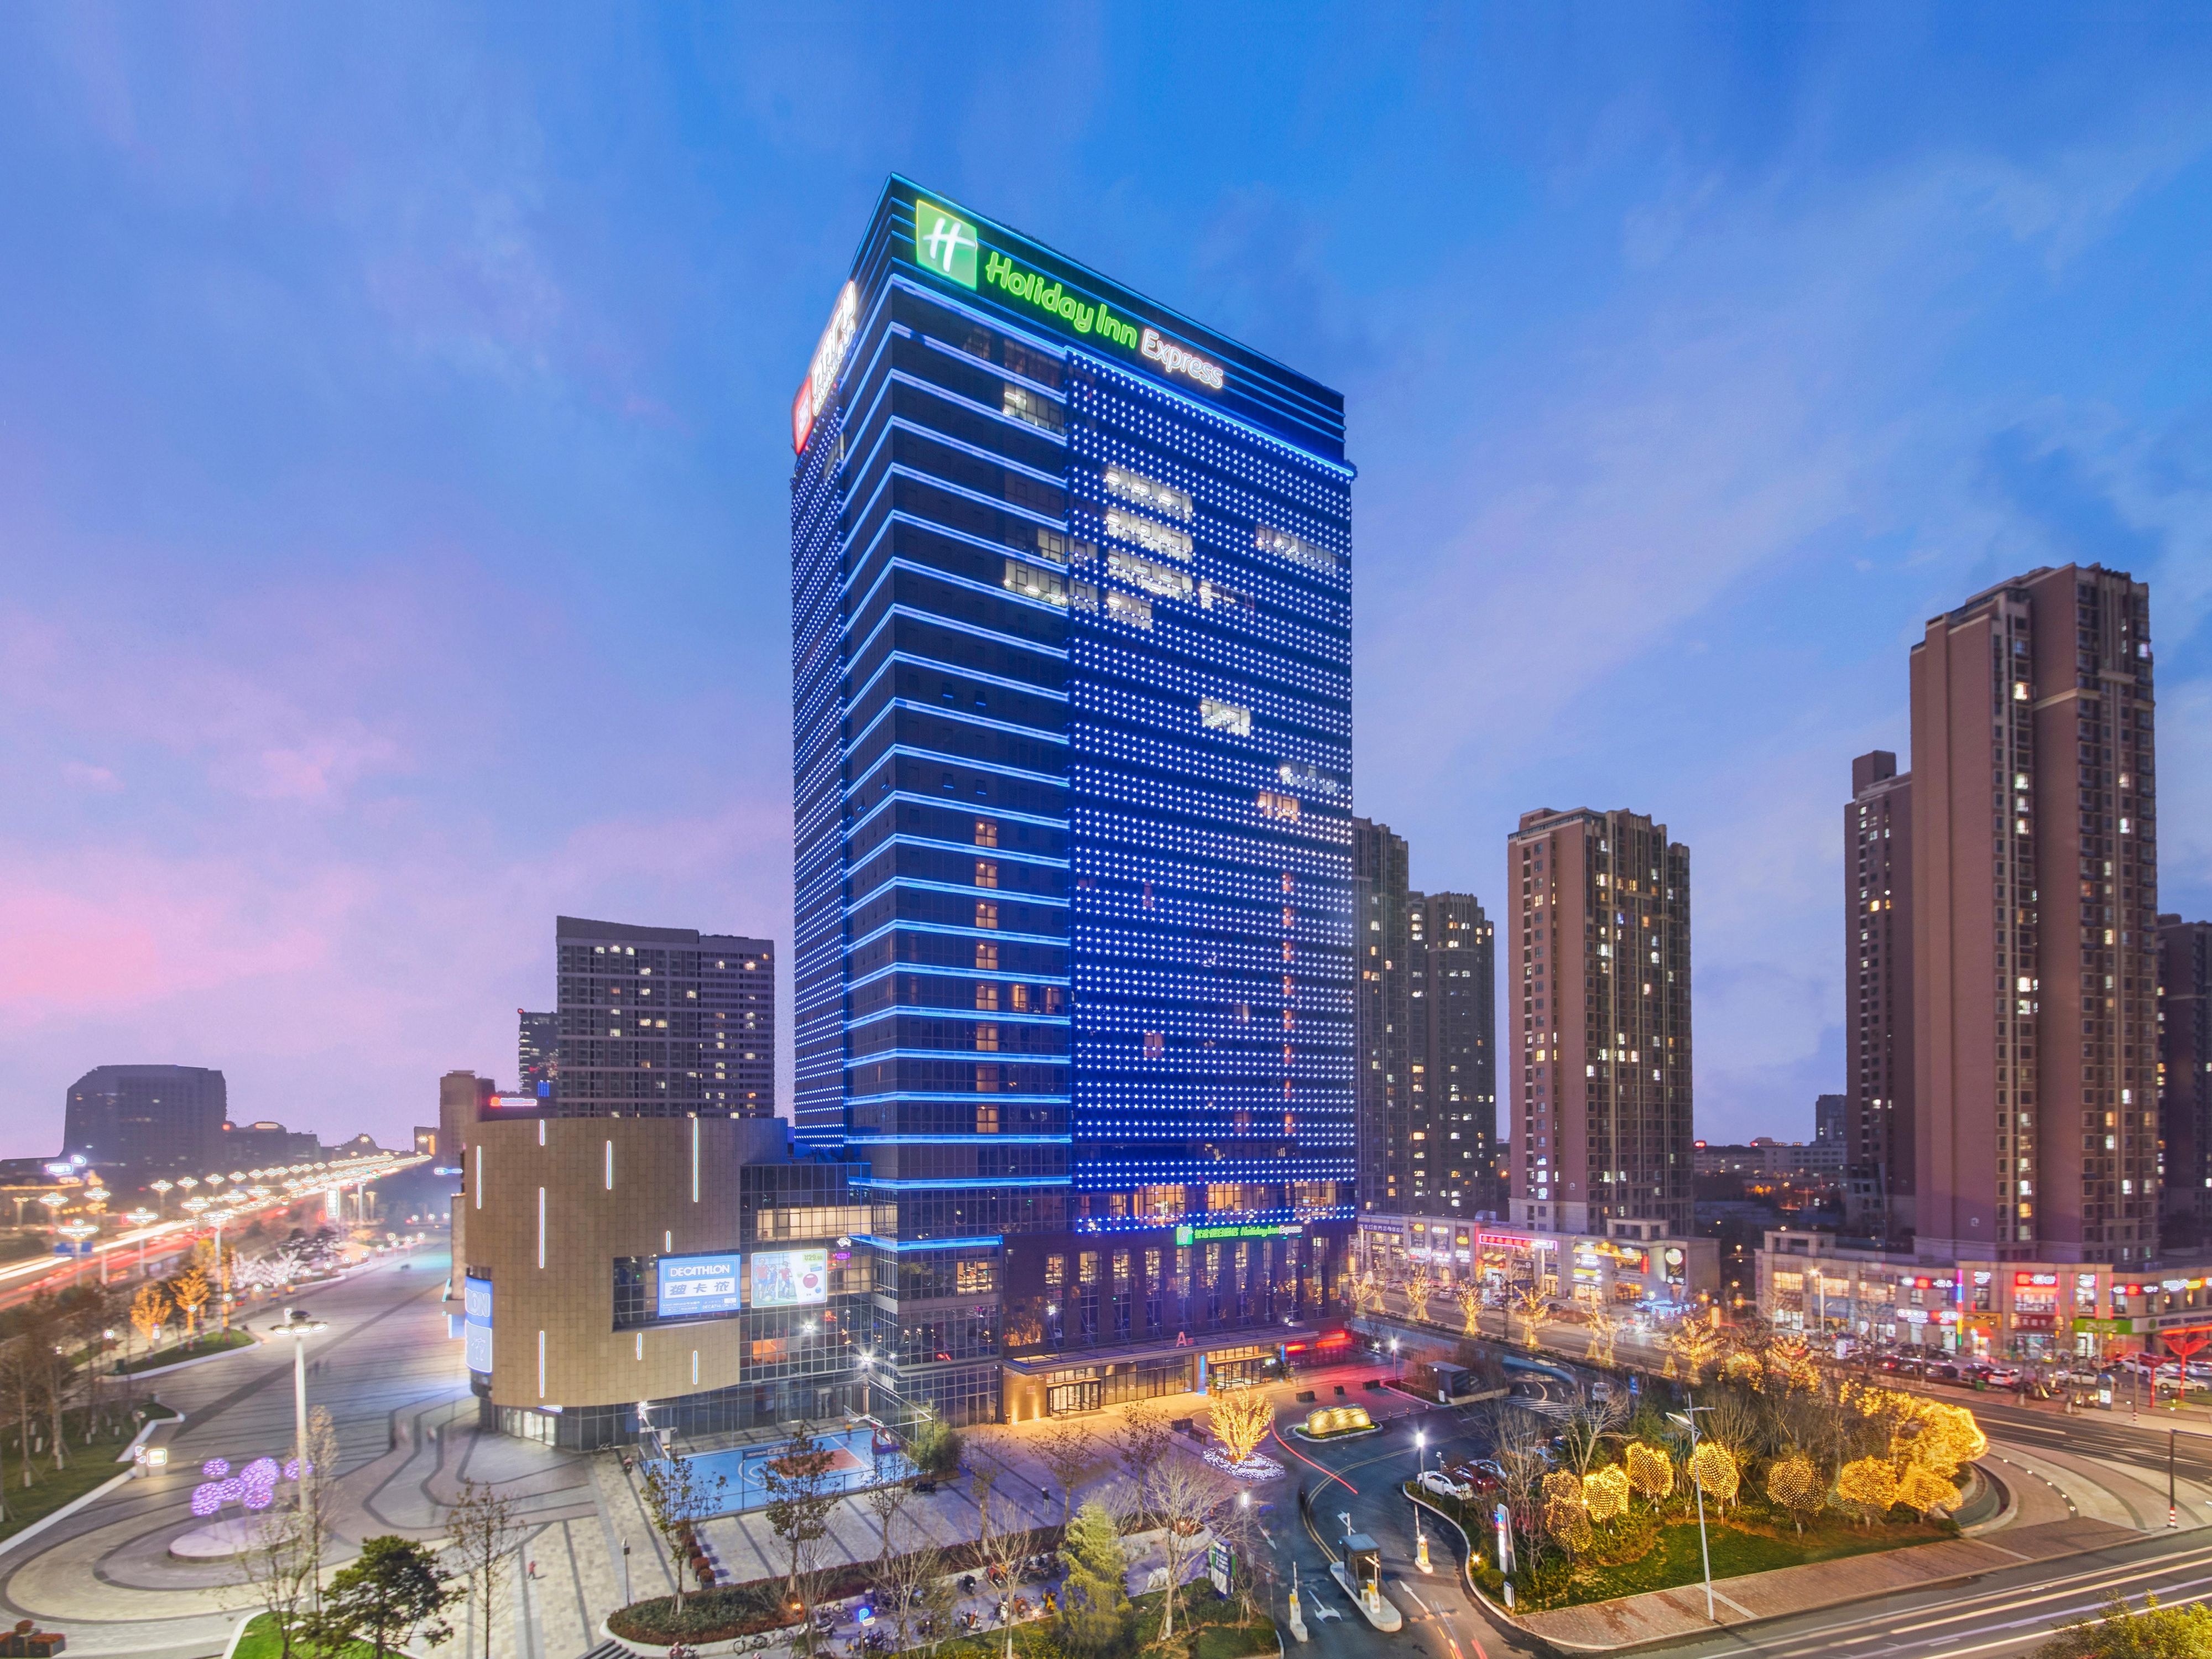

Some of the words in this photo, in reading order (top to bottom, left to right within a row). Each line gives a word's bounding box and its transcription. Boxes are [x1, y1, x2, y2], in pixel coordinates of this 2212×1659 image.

[985, 252, 1094, 333] Holiday
[1096, 304, 1138, 349] Inn
[1141, 328, 1224, 388] Express
[1240, 1226, 1267, 1237] Holiday
[1267, 1225, 1279, 1234] Inn
[1279, 1225, 1302, 1235] Express
[670, 1264, 730, 1277] DECATHLON
[670, 1281, 729, 1295] 迪卡侬
[859, 1609, 869, 1622] P
